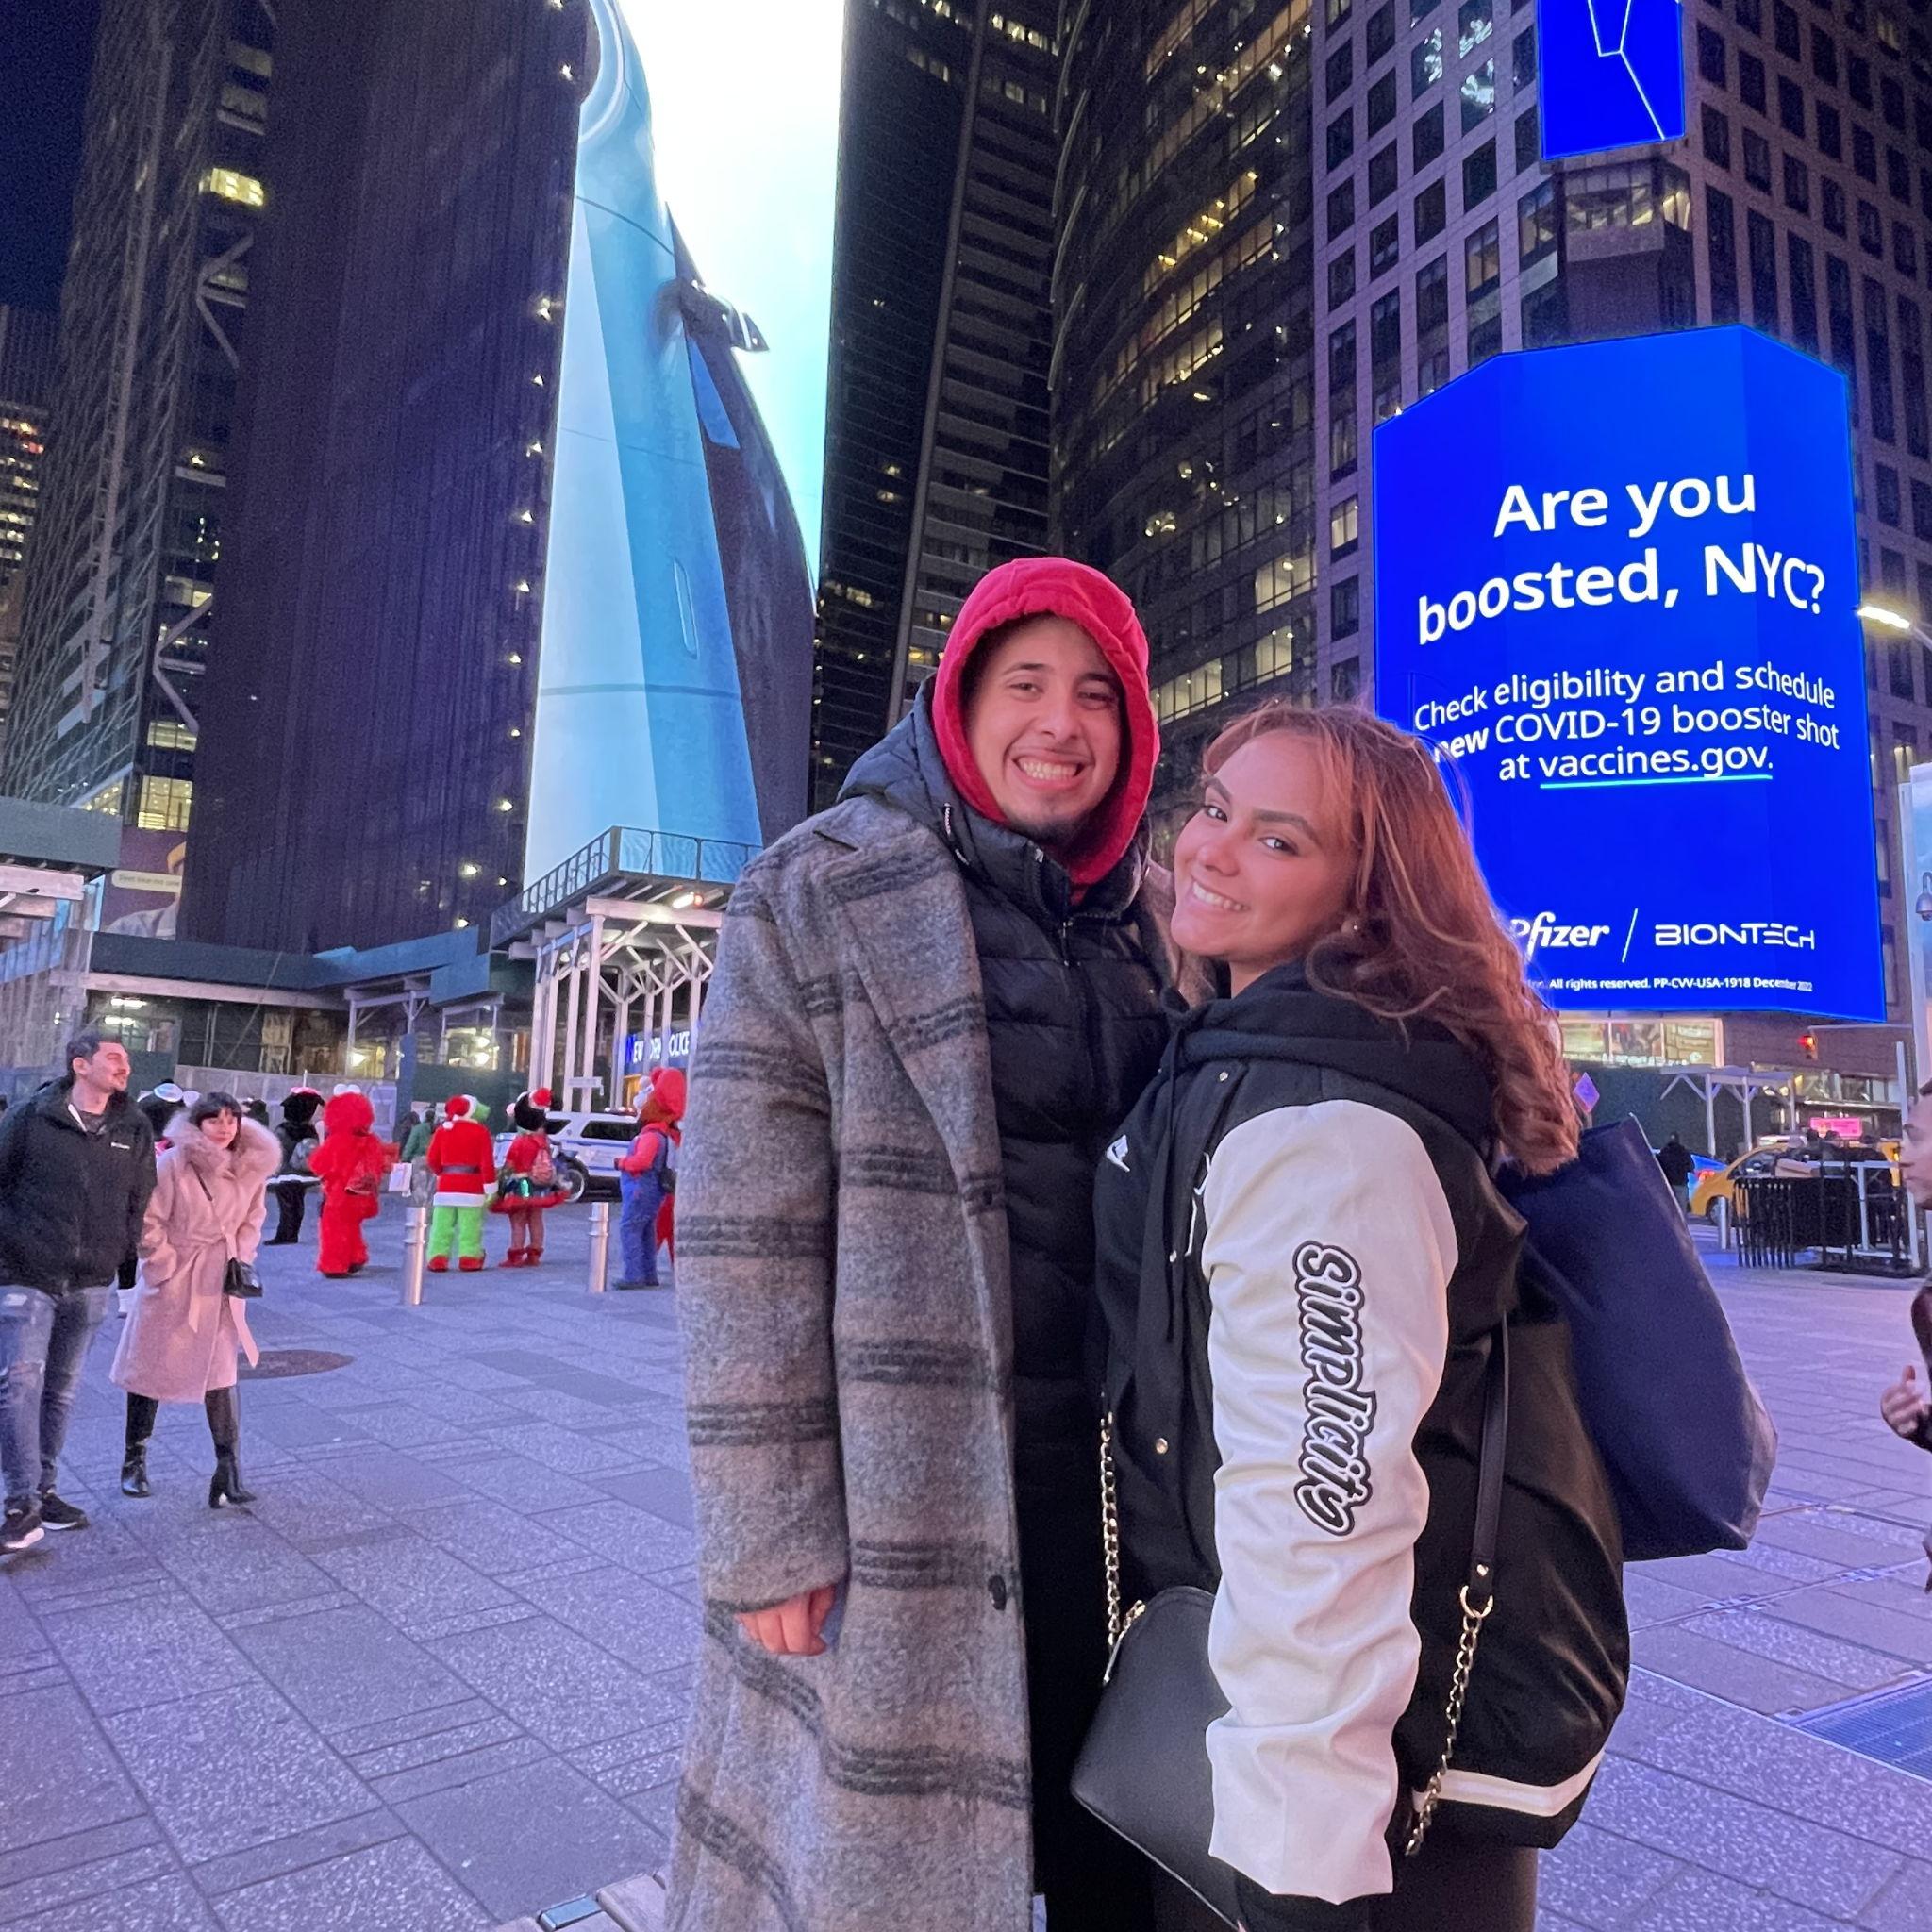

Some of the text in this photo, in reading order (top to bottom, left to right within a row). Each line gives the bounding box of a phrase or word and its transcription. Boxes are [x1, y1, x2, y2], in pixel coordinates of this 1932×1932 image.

[1494, 474, 1756, 538] Are you
[1419, 542, 1825, 645] boosted, NYC?
[1414, 661, 1835, 731] Check eligibility and schedule
[1495, 707, 1661, 744] COVID-19
[1673, 704, 1791, 735] booster
[1796, 713, 1840, 751] shot
[1499, 745, 1774, 783] at vaccines.gov.
[1549, 978, 1564, 989] All
[1565, 978, 1598, 991] rights
[1599, 978, 1651, 989] reserved.
[668, 1030, 691, 1057] OLICE
